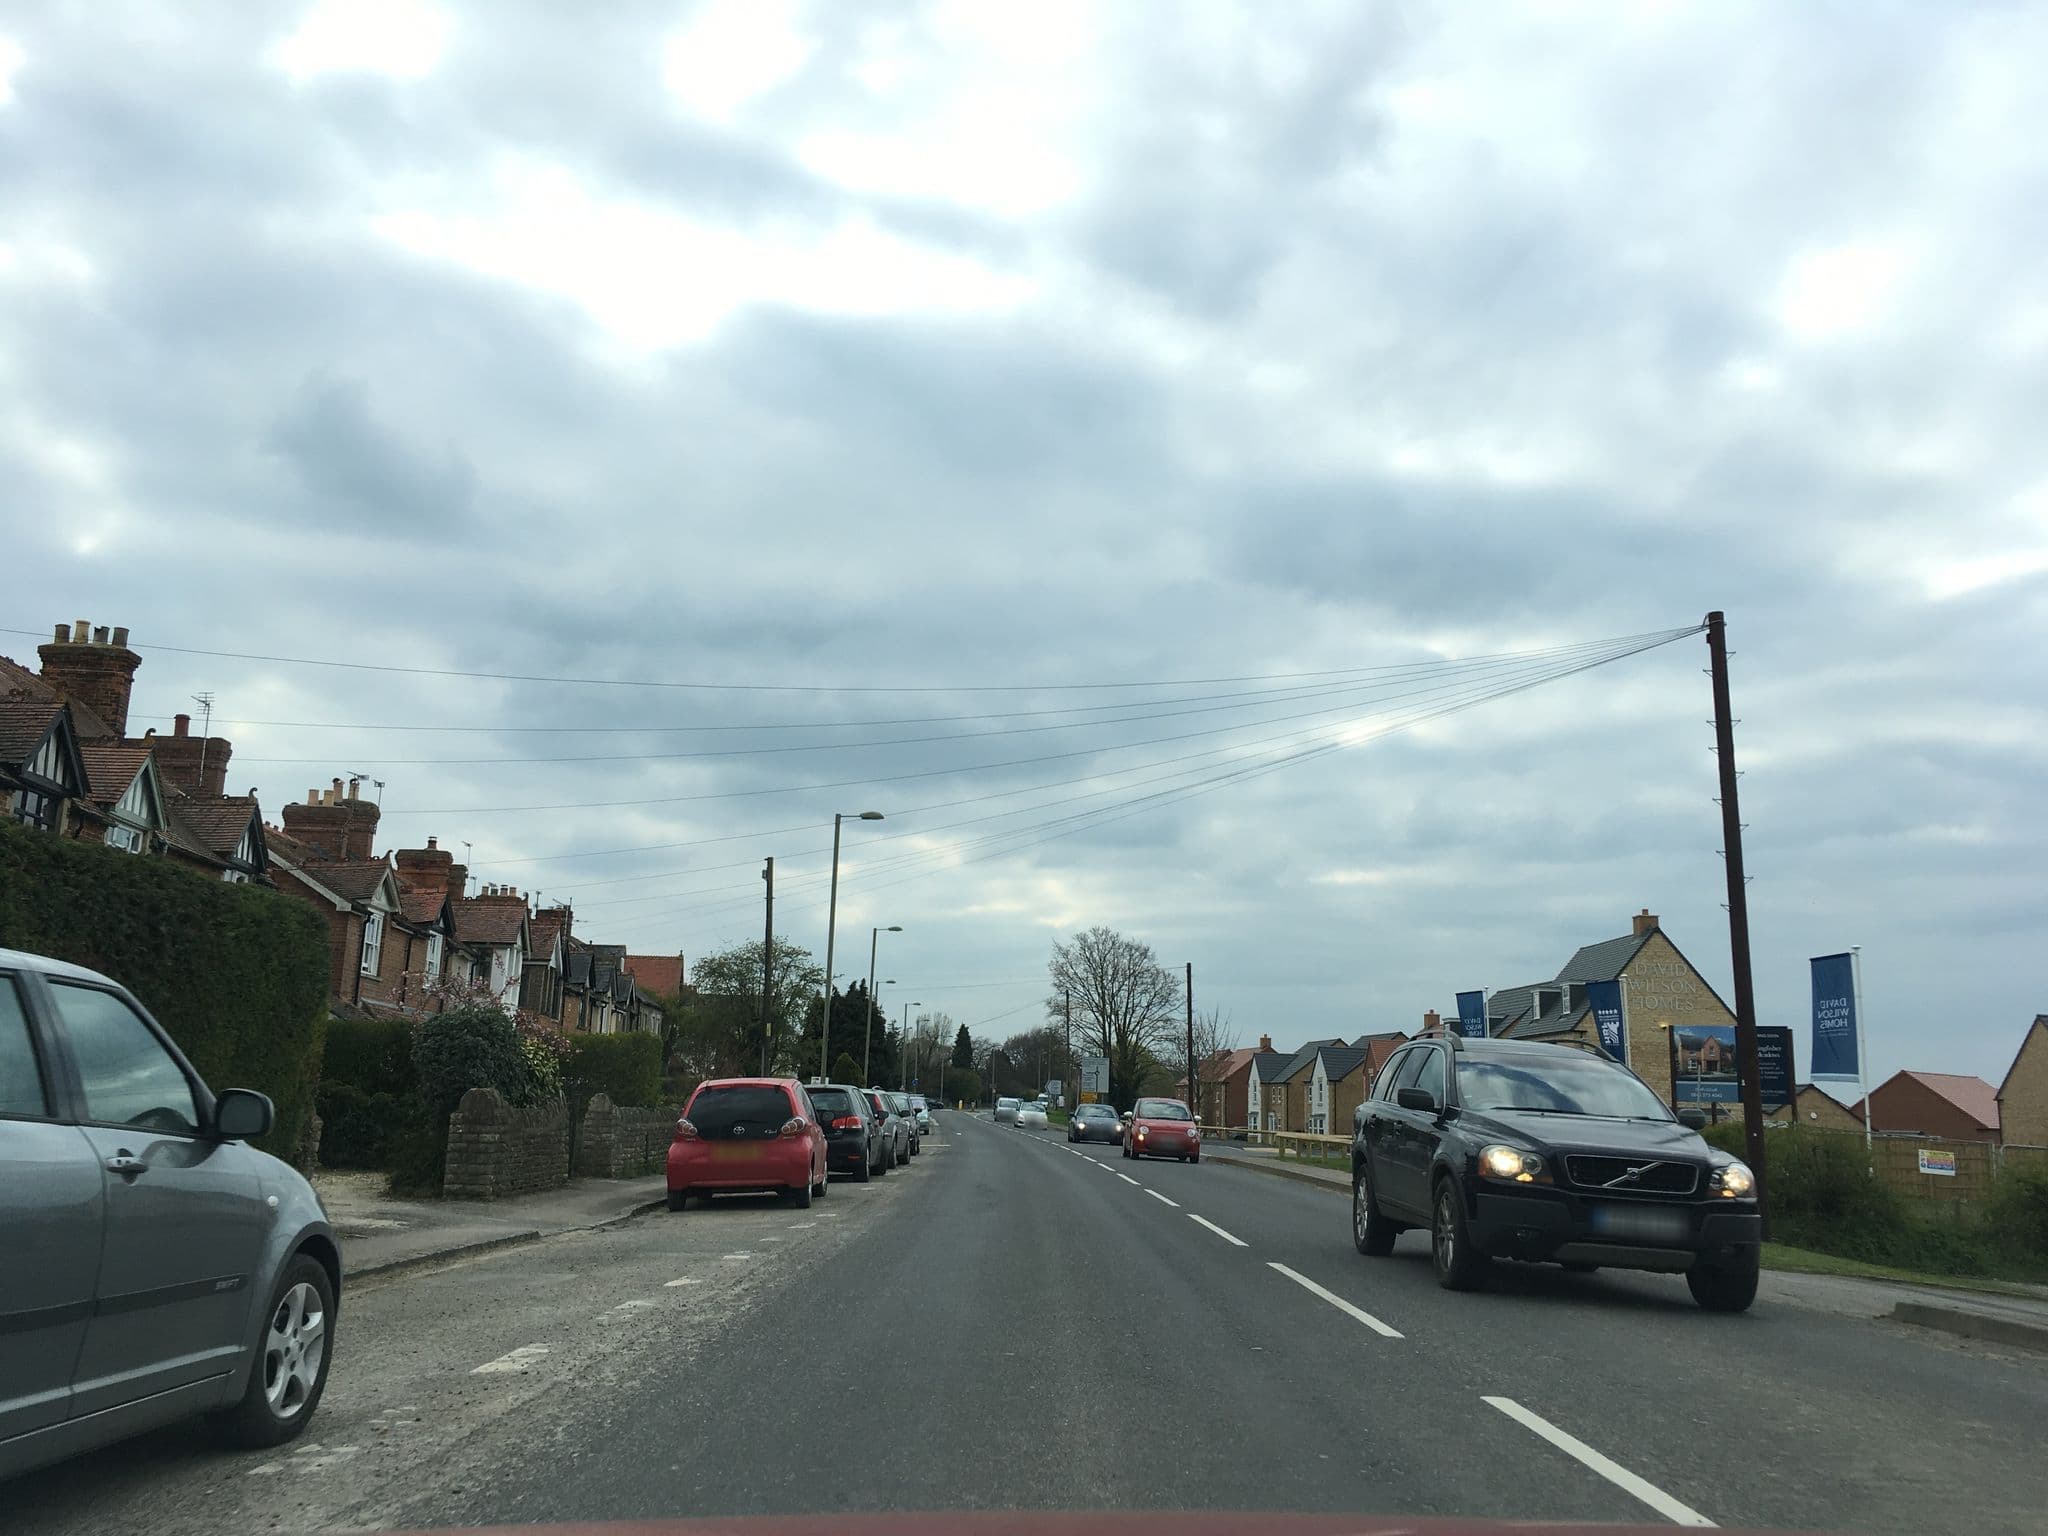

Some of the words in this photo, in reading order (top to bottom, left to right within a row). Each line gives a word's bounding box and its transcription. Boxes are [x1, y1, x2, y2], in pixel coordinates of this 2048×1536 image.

[1635, 962, 1687, 977] DAVID
[1628, 978, 1697, 993] WILSON
[1632, 995, 1694, 1011] HOMES
